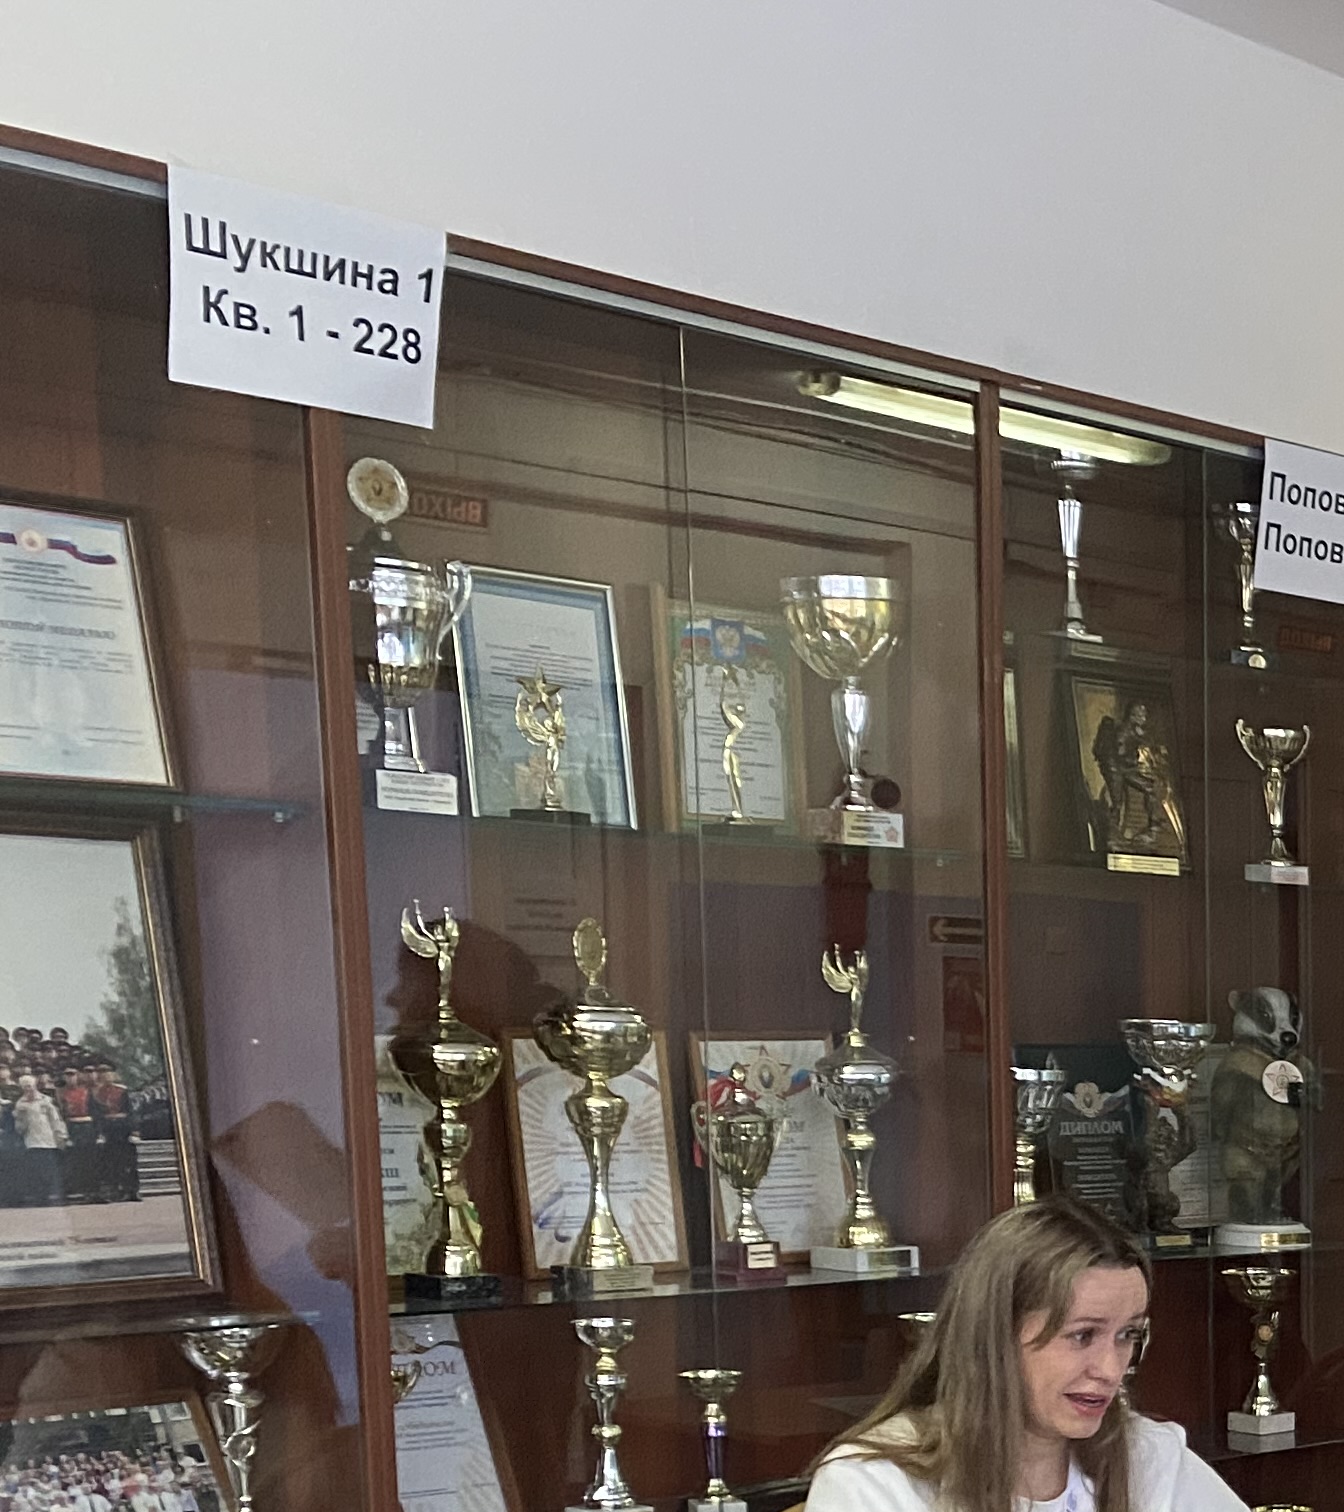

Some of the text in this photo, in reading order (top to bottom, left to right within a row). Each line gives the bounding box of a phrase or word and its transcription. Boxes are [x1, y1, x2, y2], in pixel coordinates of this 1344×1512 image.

[183, 212, 434, 303] Шукшина 1
[202, 285, 271, 335] Кв.
[288, 304, 305, 342] 1
[352, 317, 422, 365] 228
[1058, 1120, 1125, 1136] ДИПЛОМ
